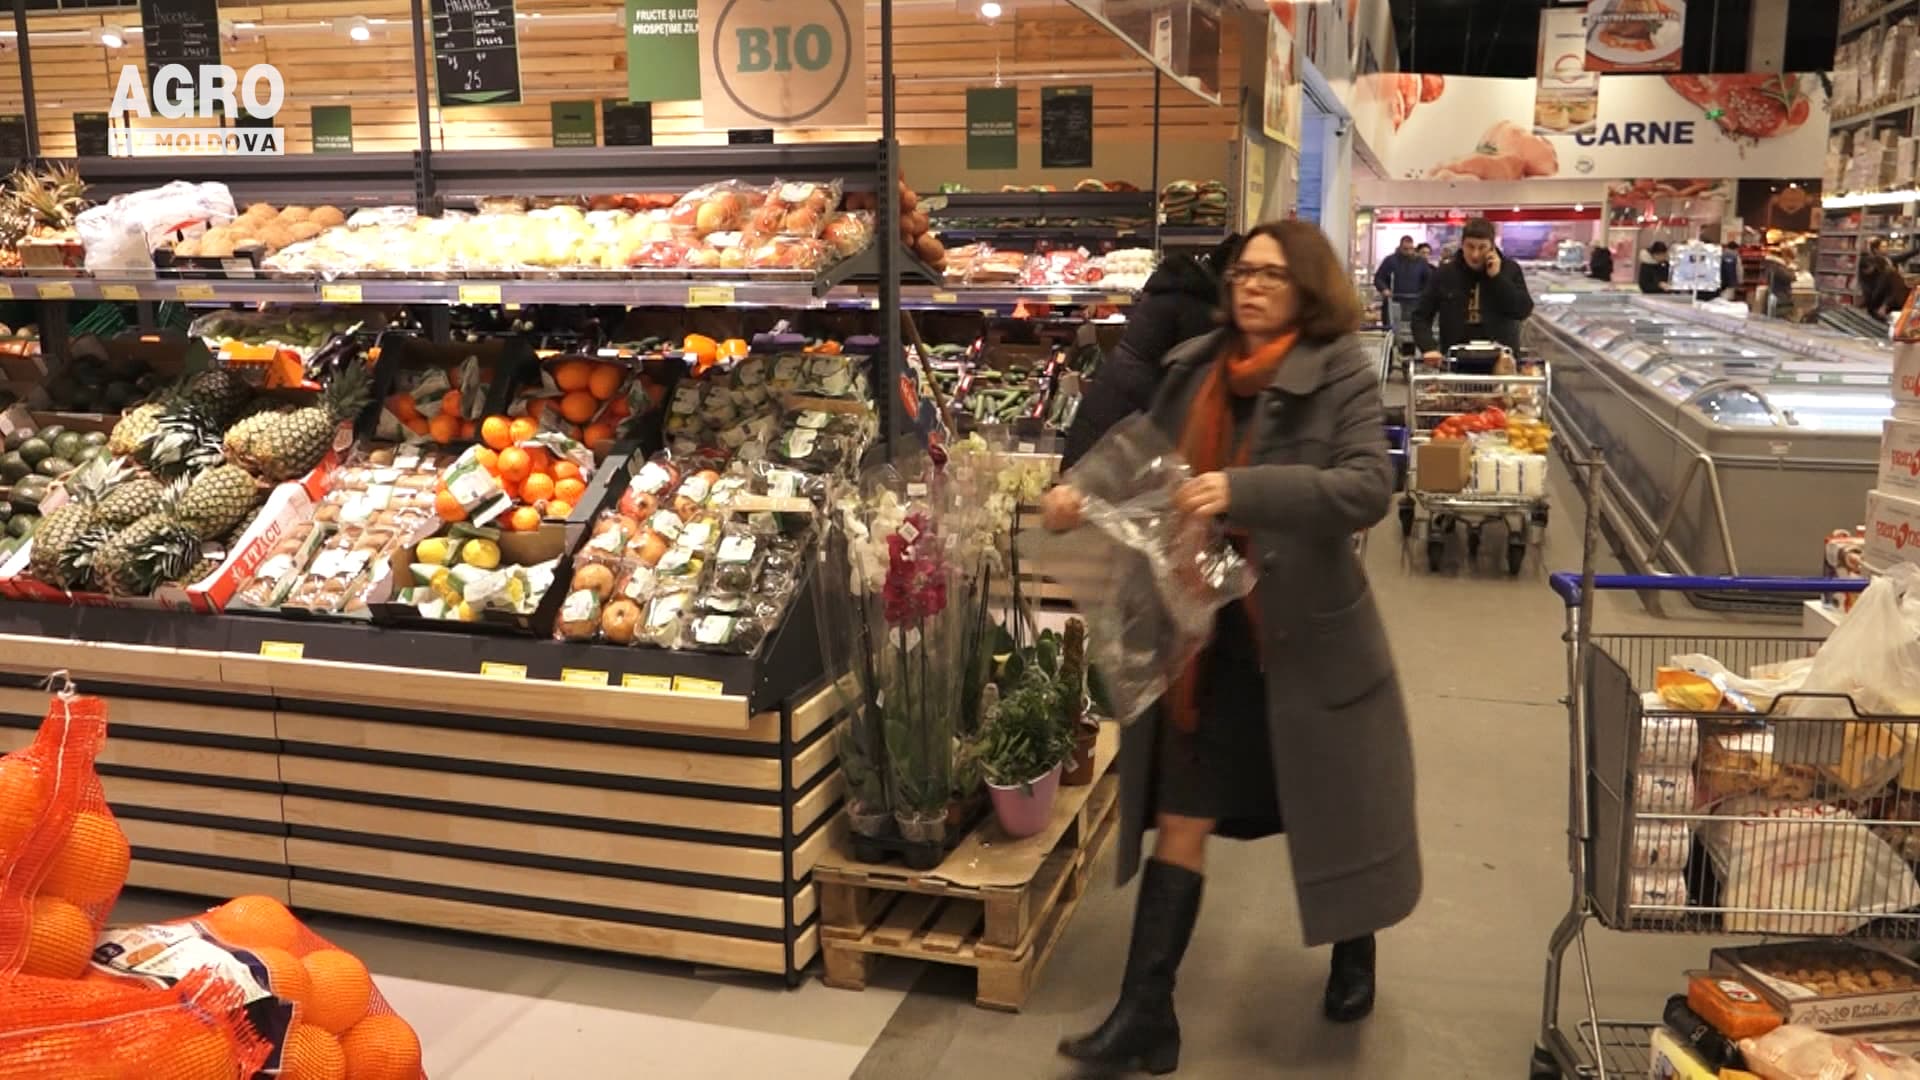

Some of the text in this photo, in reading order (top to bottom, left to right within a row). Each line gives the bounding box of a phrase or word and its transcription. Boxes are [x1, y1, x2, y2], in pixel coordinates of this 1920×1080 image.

[636, 9, 667, 21] FRUCTE
[669, 9, 676, 22] ȘI
[633, 23, 682, 36] PROSPEȚIME
[736, 23, 832, 72] BIO
[464, 69, 482, 90] 25
